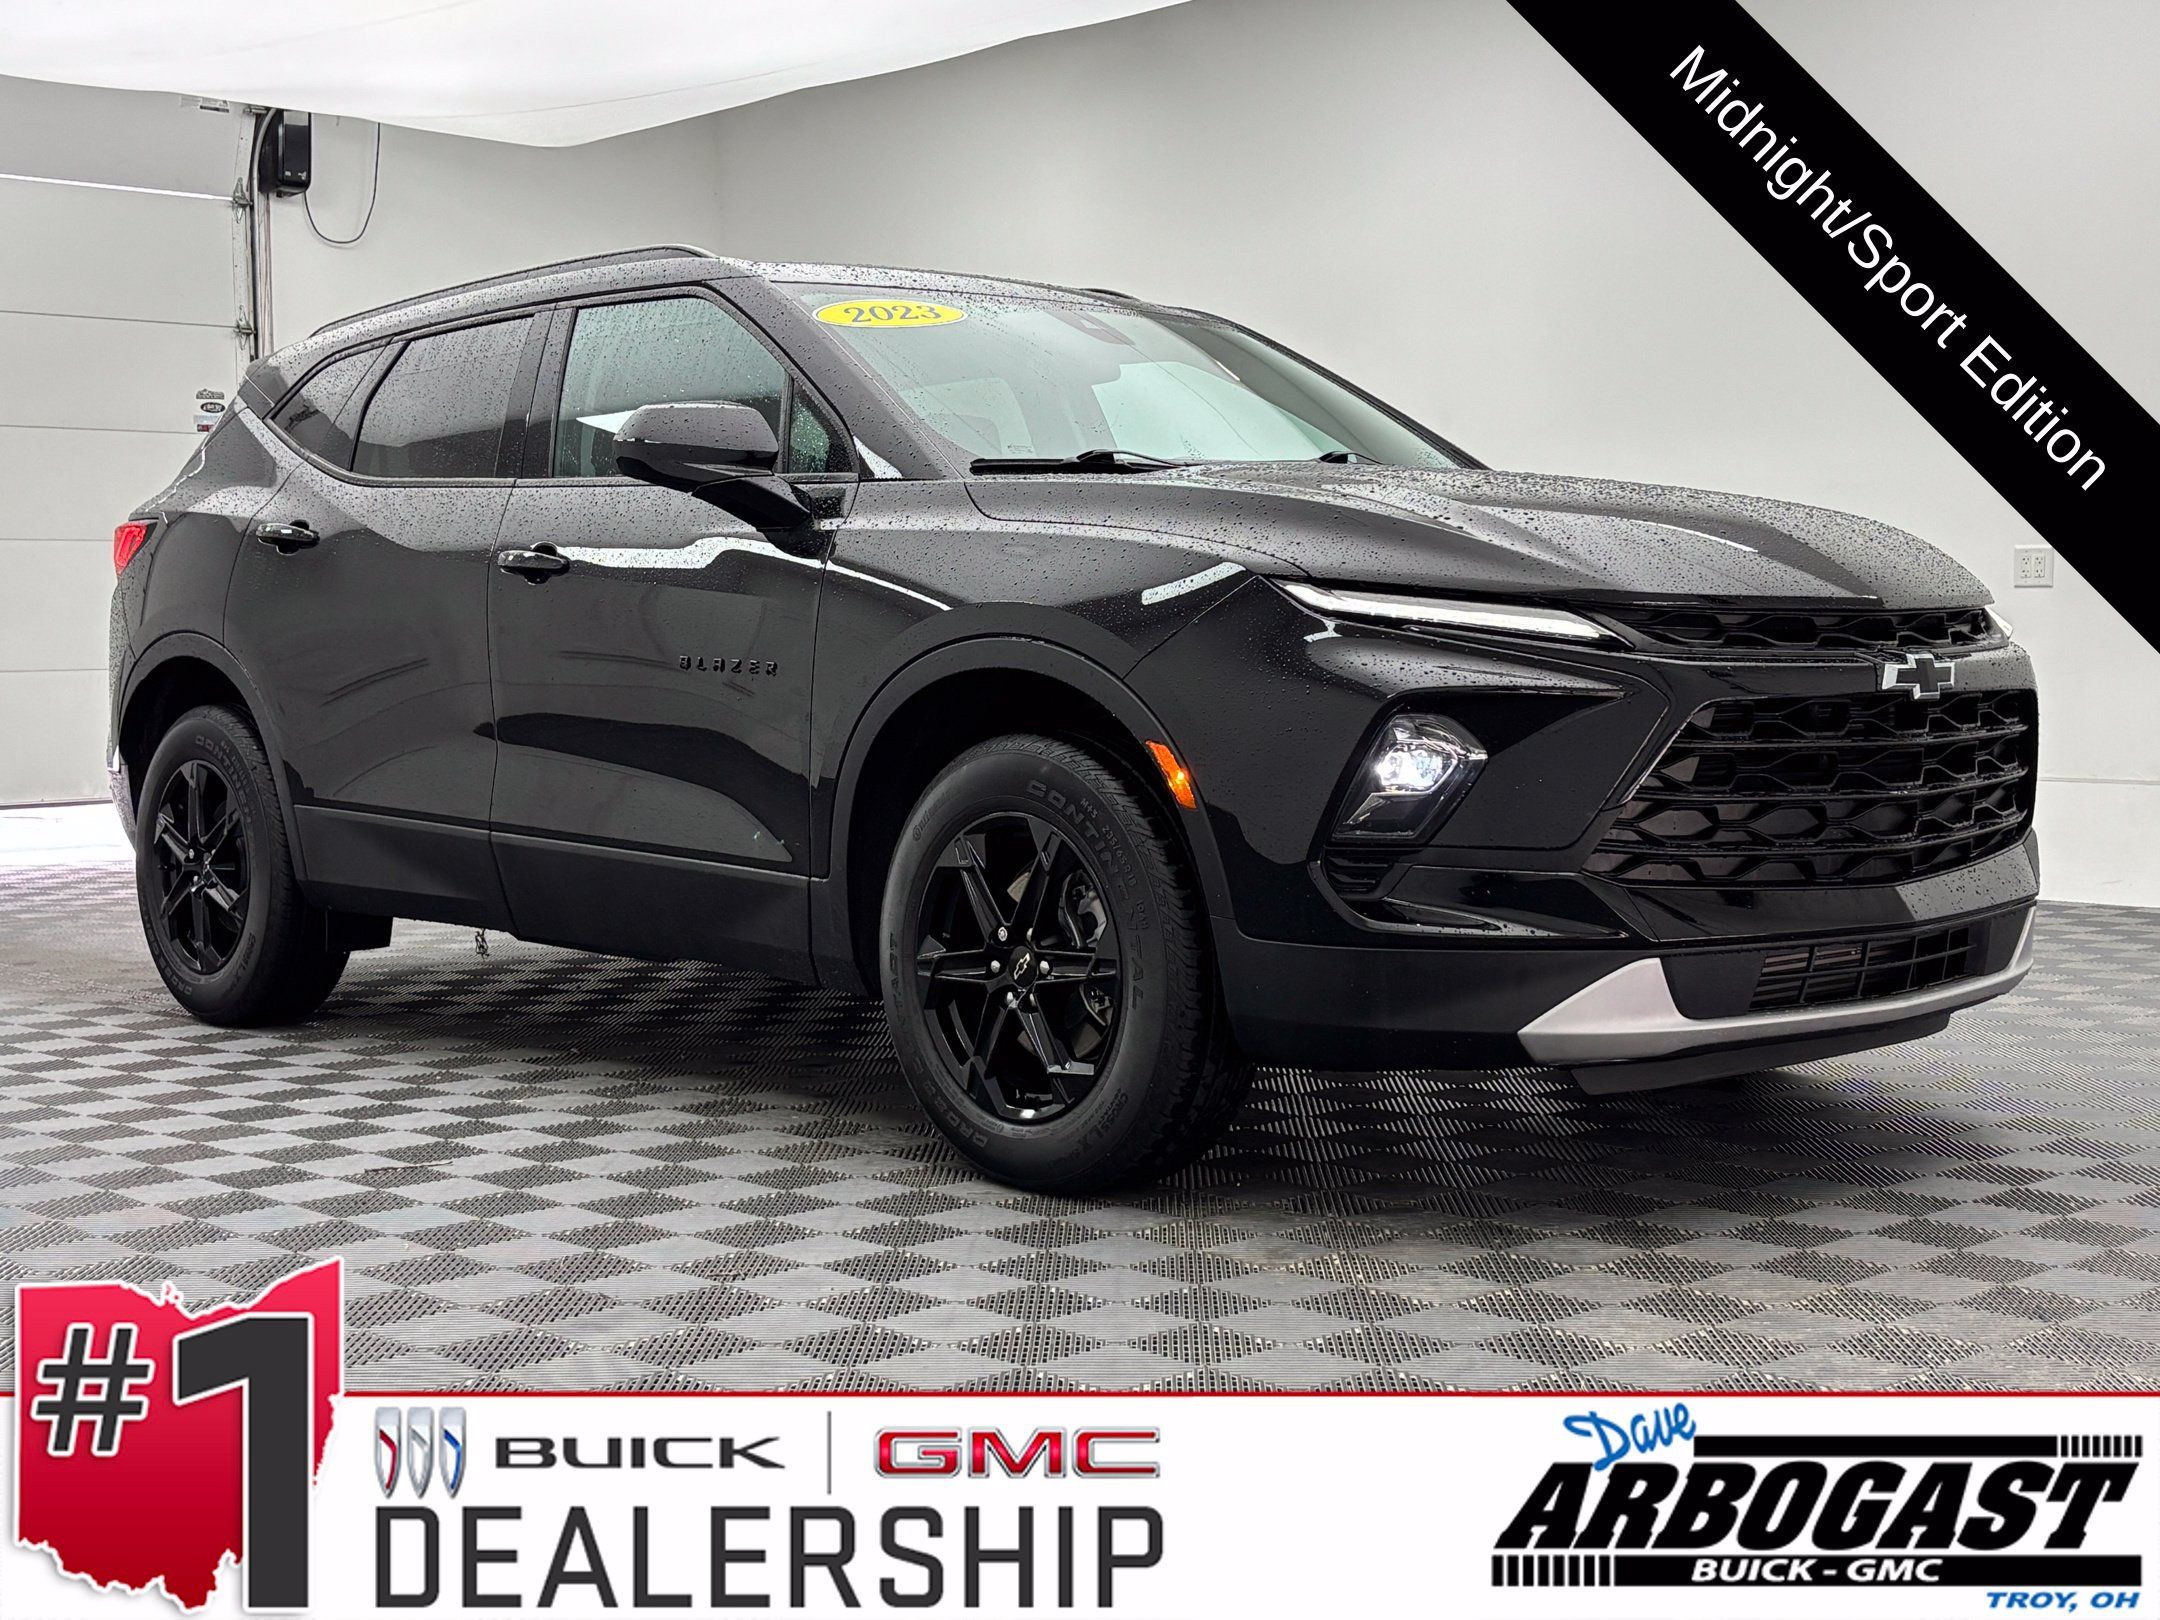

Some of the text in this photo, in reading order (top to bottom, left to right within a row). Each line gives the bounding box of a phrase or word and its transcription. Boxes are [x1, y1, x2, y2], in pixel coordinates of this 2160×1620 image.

[844, 305, 942, 323] 2023
[679, 655, 779, 677] BLAZER
[1026, 779, 1144, 1009] CONTINENTAL
